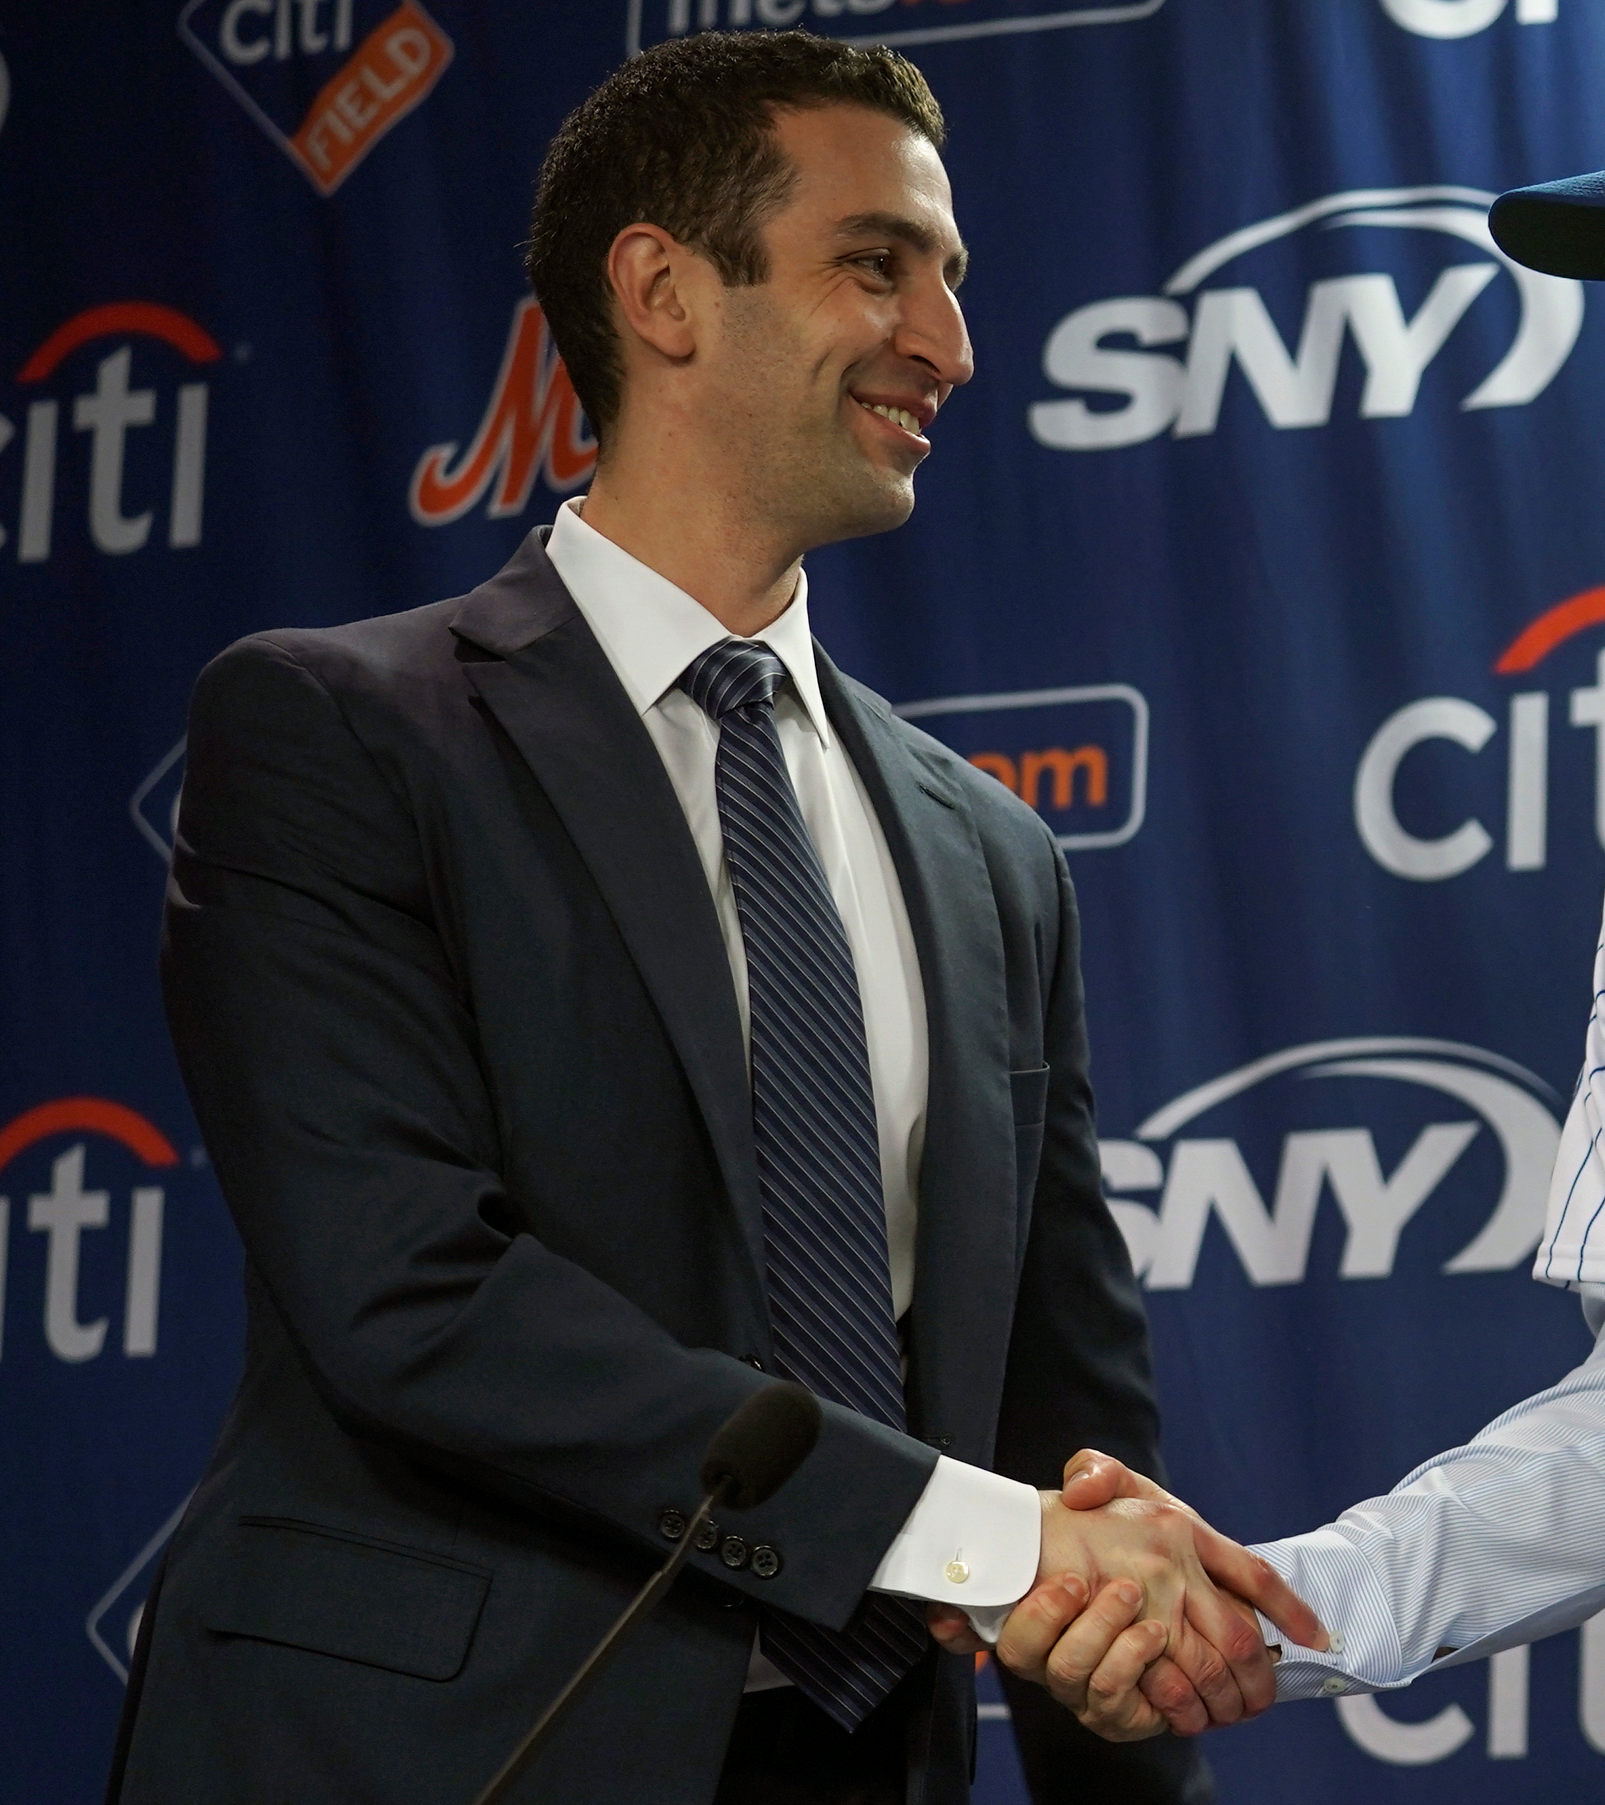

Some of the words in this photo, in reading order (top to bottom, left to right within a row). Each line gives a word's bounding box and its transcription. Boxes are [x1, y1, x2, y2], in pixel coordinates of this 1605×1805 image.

[304, 27, 432, 171] FIELD
[1027, 262, 1500, 452] SNY
[0, 344, 209, 563] iti
